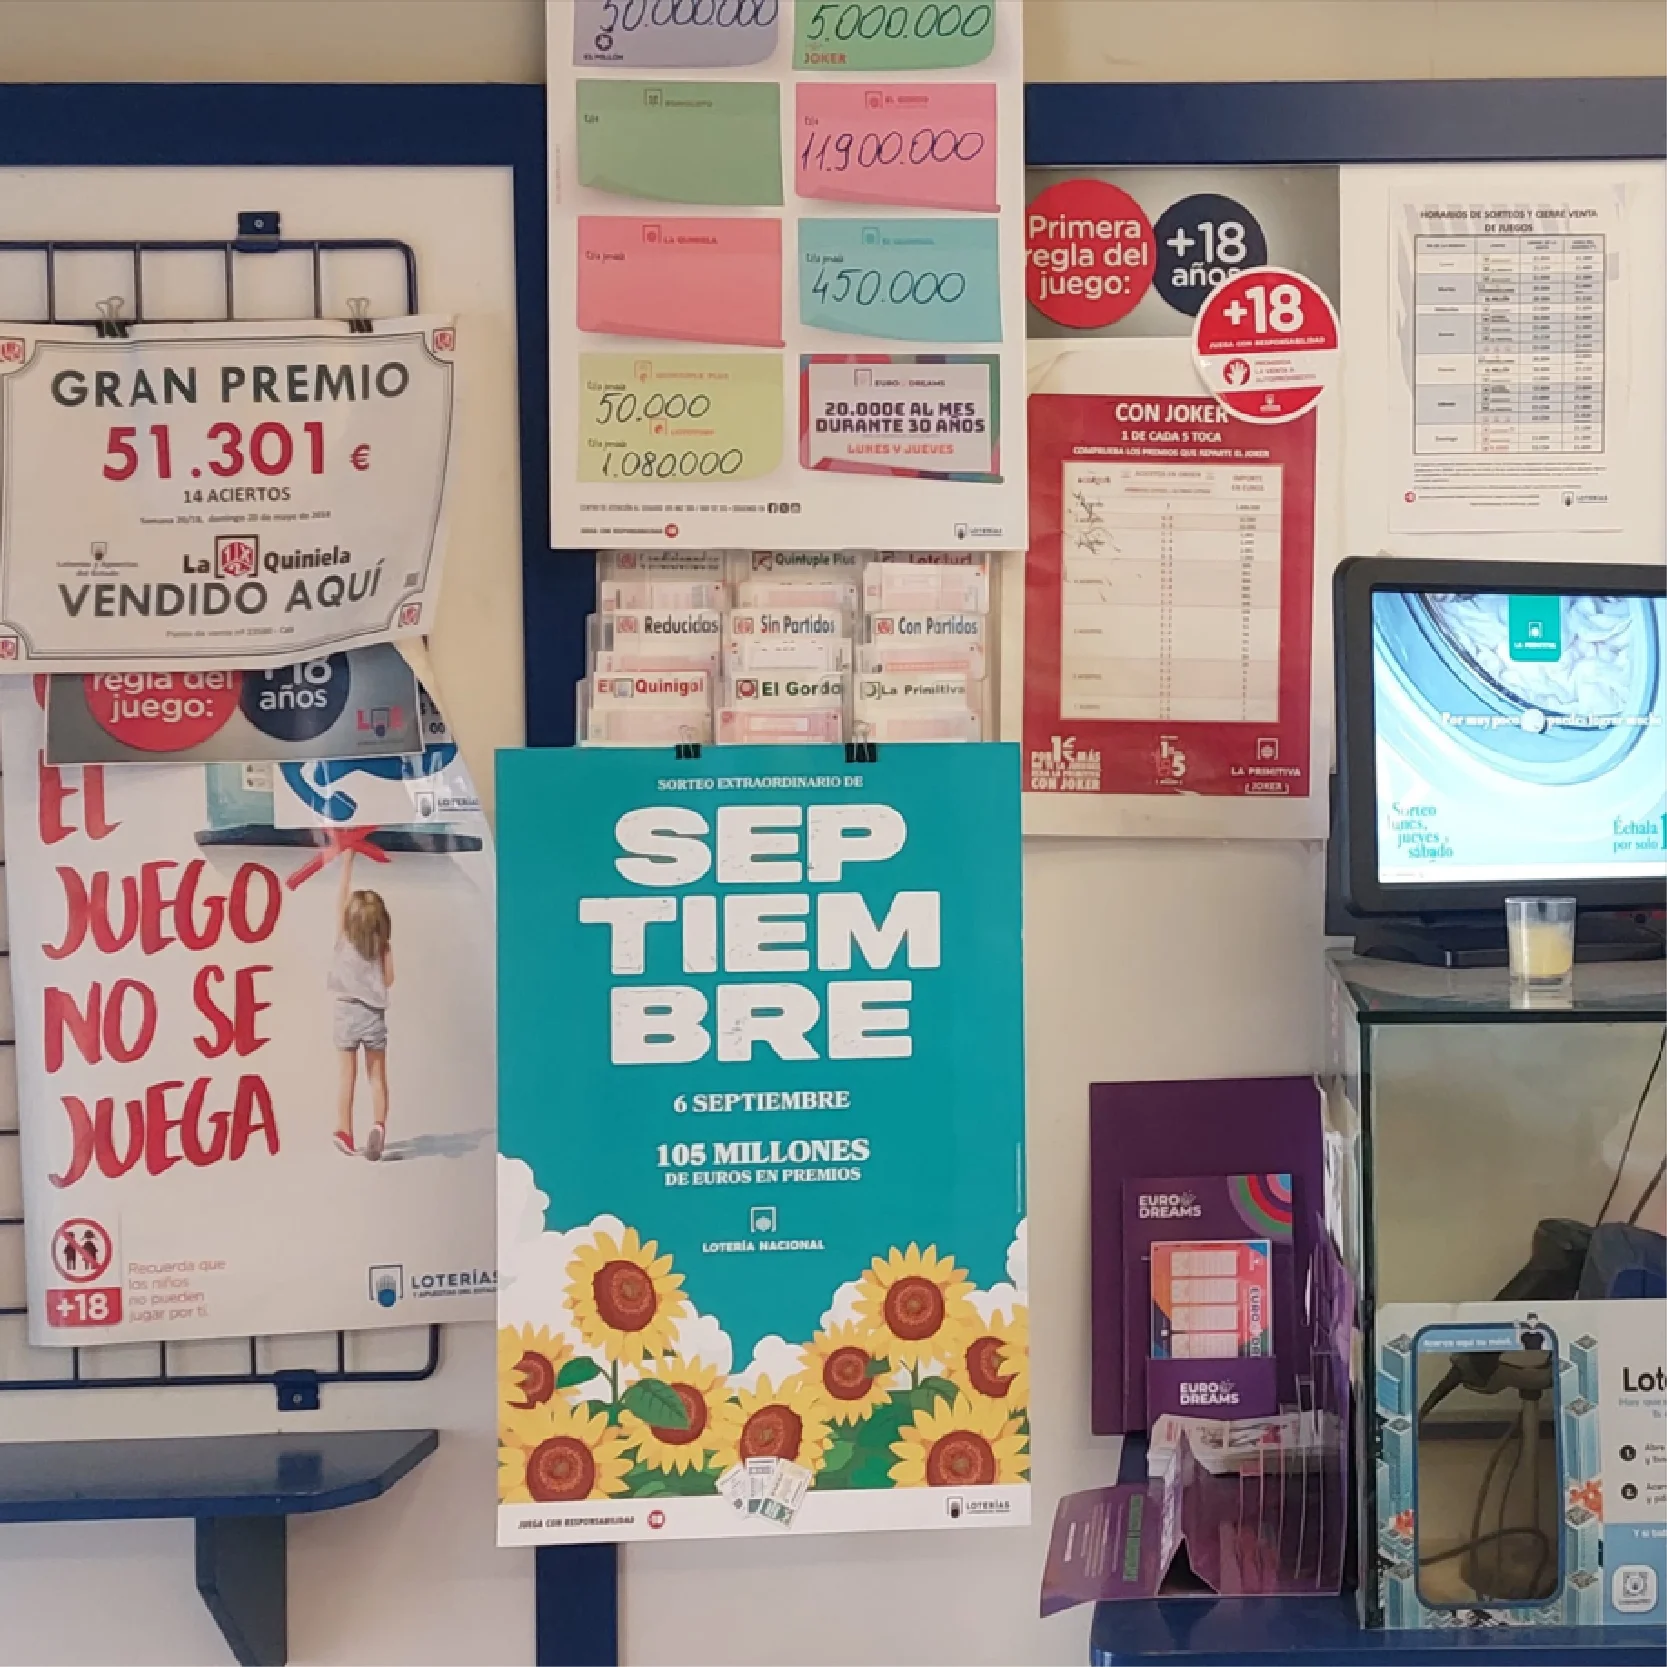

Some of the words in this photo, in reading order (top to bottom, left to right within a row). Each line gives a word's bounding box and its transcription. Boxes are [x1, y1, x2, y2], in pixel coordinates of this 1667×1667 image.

[806, 4, 992, 41] 5.000.000
[804, 53, 847, 64] JOKER
[801, 129, 985, 172] 11.900.000
[1028, 213, 1141, 239] Primera
[1166, 221, 1248, 264] +18
[1025, 241, 1095, 272] regla
[1102, 241, 1148, 267] del
[811, 268, 966, 306] 450.000
[1039, 270, 1131, 300] juego:
[1222, 283, 1304, 334] +18
[51, 367, 197, 407] GRAN
[220, 362, 409, 403] PREMIO
[596, 394, 711, 424] 50.000
[910, 402, 934, 416] AL
[939, 402, 975, 416] MES
[1115, 403, 1160, 423] CON
[1165, 404, 1229, 424] JOKER
[816, 418, 903, 433] DURANTE
[908, 418, 932, 433] 30
[936, 414, 985, 433] AÑOS
[1132, 431, 1146, 441] DE
[103, 421, 324, 480] 51.301
[349, 443, 371, 471] €
[183, 490, 202, 504] 14
[207, 487, 291, 503] ACIERTOS
[183, 554, 210, 573] La
[264, 545, 351, 573] Quiniela
[775, 552, 830, 568] Quintuple
[58, 581, 267, 617] VENDIDO
[285, 558, 385, 613] AQUÍ
[644, 614, 719, 634] Reducidas
[761, 614, 781, 634] Sin
[783, 614, 836, 634] Partidos
[898, 616, 922, 634] Con
[926, 615, 978, 635] Partidos
[93, 672, 173, 695] regla
[184, 670, 233, 689] del
[635, 679, 704, 697] Quinigol
[762, 682, 779, 697] El
[785, 682, 842, 697] Gordo
[881, 686, 897, 695] La
[904, 685, 965, 695] Primitiva
[260, 684, 328, 710] años
[109, 694, 214, 723] juego:
[657, 779, 714, 790] SORTEO
[717, 776, 841, 789] EXTRAORDINARIO
[843, 776, 864, 787] DE
[38, 749, 123, 845] EL
[1392, 802, 1436, 816] Sorteo
[1613, 814, 1658, 835] Échala
[613, 804, 908, 887] SEP
[1398, 832, 1439, 849] jueves
[1408, 842, 1453, 858] sábado
[1613, 841, 1632, 853] por
[1636, 837, 1658, 850] solo
[41, 860, 282, 960] JUEGO
[579, 891, 941, 975] TIEM
[44, 978, 157, 1073] NO
[193, 965, 273, 1058] SE
[610, 980, 913, 1065] BRE
[673, 1094, 687, 1113] 6
[692, 1091, 850, 1113] SEPTIEMBRE
[48, 1075, 280, 1189] JUEGA
[656, 1142, 707, 1167] 105
[712, 1138, 871, 1165] MILLONES
[664, 1172, 689, 1186] DE
[692, 1170, 752, 1185] EUROS
[755, 1170, 779, 1183] EN
[782, 1167, 862, 1182] PREMIOS
[1139, 1195, 1180, 1206] EURO
[1139, 1206, 1201, 1218] DREAMS
[702, 1240, 755, 1253] LOTERÍA
[759, 1240, 826, 1251] NACIONAL
[128, 1261, 194, 1274] Recuerda
[199, 1260, 226, 1272] que
[56, 1295, 109, 1320] +18
[128, 1296, 147, 1306] no
[150, 1292, 204, 1306] pueden
[1180, 1383, 1218, 1393] EURO
[1622, 1365, 1667, 1392] Lot
[1180, 1393, 1239, 1405] DREAMS
[966, 1499, 1010, 1510] LOTERÍAS
